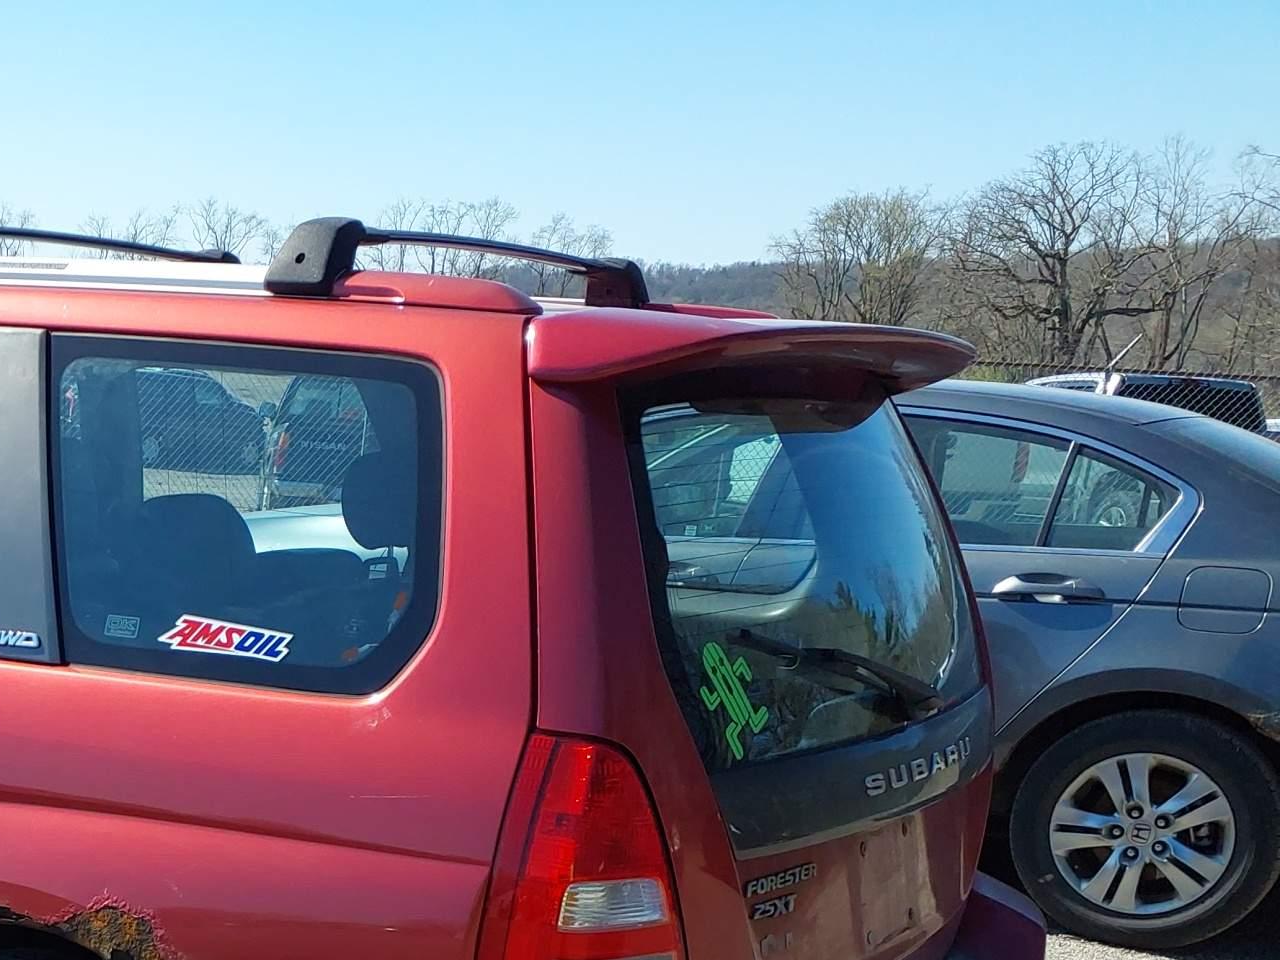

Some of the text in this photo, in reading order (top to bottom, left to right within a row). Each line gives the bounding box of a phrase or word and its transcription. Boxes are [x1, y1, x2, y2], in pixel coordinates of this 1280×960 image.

[166, 618, 288, 659] AMSOIL
[864, 736, 971, 797] SUBARU
[746, 863, 817, 898] FORESTER
